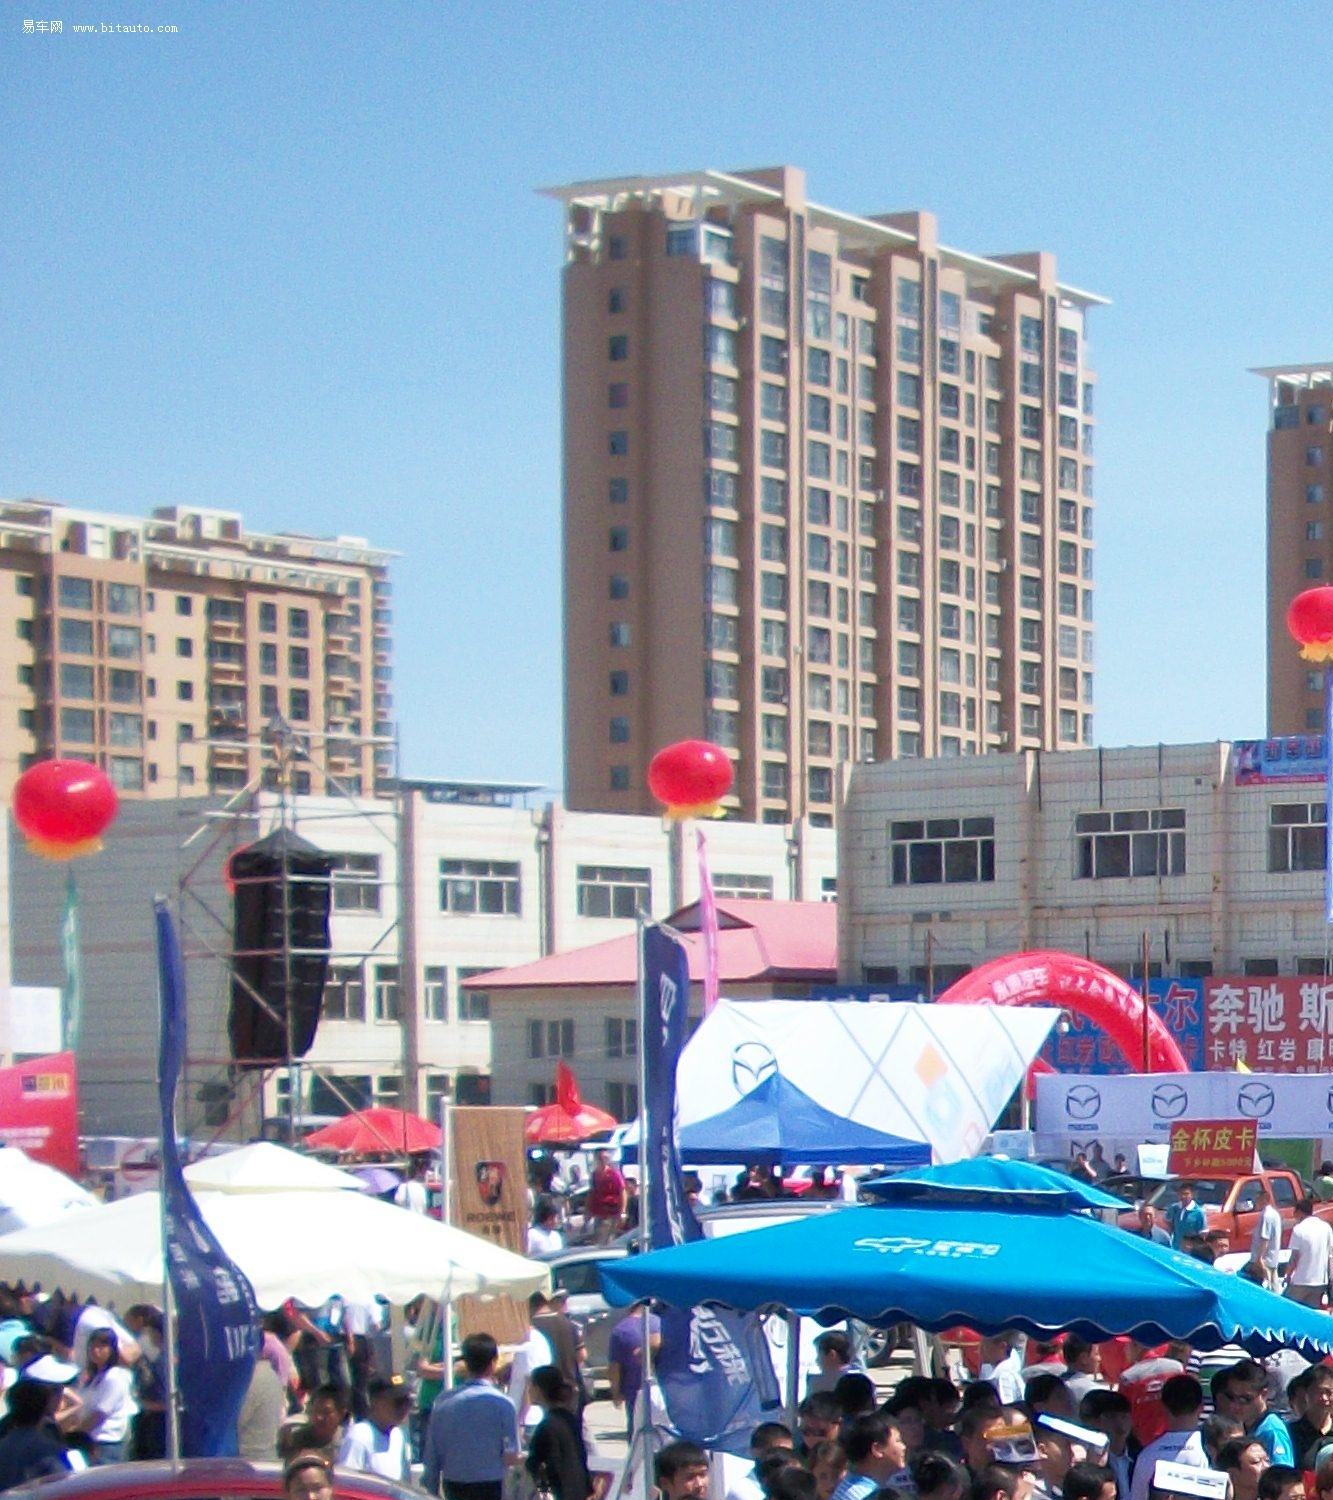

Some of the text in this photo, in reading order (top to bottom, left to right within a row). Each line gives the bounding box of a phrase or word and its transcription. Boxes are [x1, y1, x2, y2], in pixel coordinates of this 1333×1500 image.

[1209, 983, 1286, 1034] 奔驰
[1209, 1038, 1247, 1062] 卡特
[1257, 1038, 1297, 1062] 红岩
[1172, 1127, 1254, 1152] 金杯皮卡
